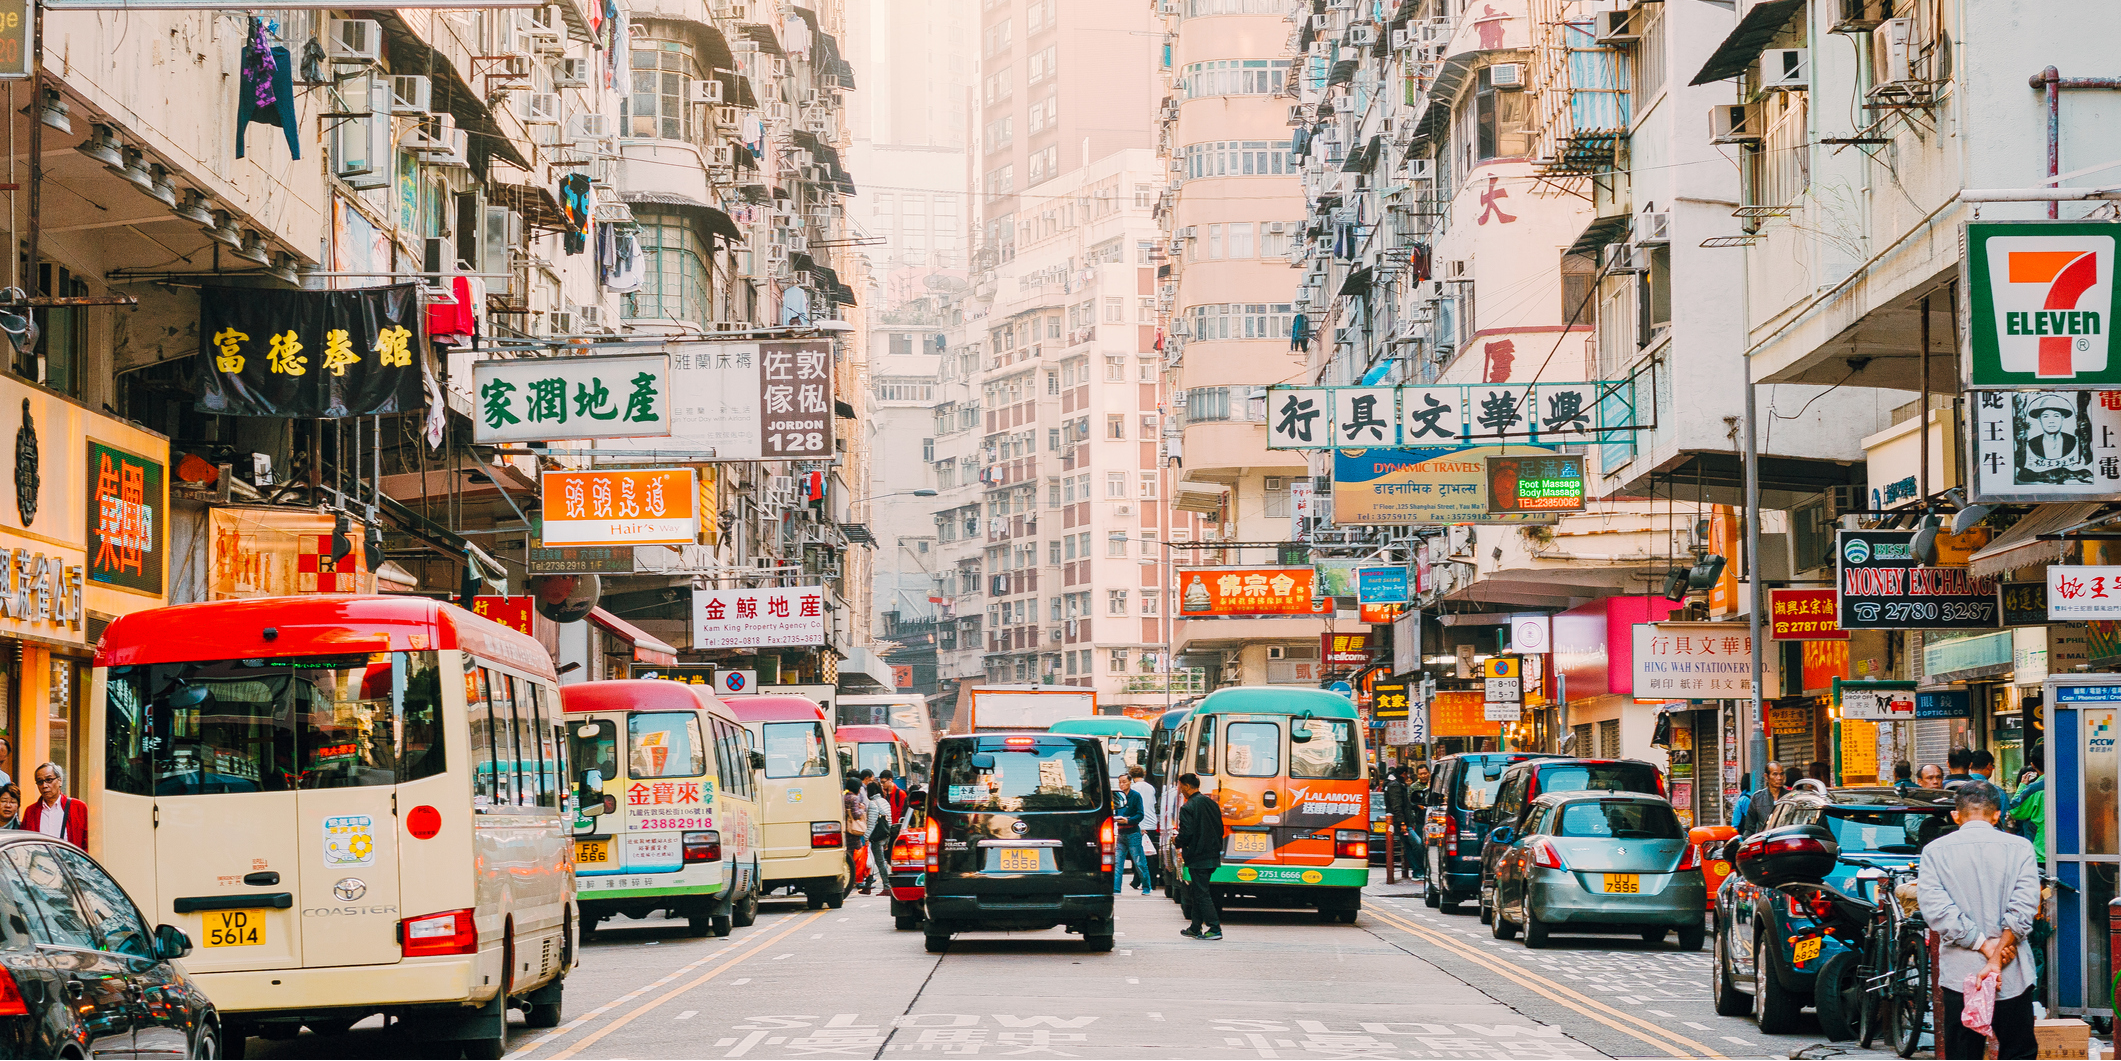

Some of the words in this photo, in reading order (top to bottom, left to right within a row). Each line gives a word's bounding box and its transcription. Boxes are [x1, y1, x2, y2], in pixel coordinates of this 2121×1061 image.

[213, 325, 413, 376] 富德拳館
[675, 353, 752, 370] 雅蘭床褥
[481, 372, 660, 430] 家潤地產
[768, 420, 824, 431] JORDON
[768, 432, 824, 451] 128
[1373, 463, 1430, 473] DYNAMIC
[1432, 463, 1480, 473] TRAVELS
[1519, 480, 1540, 489] Foot
[1542, 480, 1580, 489] Massage
[1519, 488, 1541, 498] Body
[1542, 488, 1580, 496] Massage
[1518, 498, 1579, 508] TEL:23850062
[611, 523, 655, 536] Hair's
[659, 525, 681, 533] Way
[566, 562, 587, 571] 2918
[1844, 567, 1906, 596] MONEY
[1908, 567, 1998, 596] EXCHANGE
[705, 593, 821, 620] 金鯨地產
[1885, 602, 1939, 621] 2780
[1942, 602, 1995, 621] 3287
[724, 624, 741, 633] King
[745, 623, 777, 632] Property
[779, 622, 807, 631] Agency
[811, 620, 823, 628] Co.
[1791, 621, 1818, 632] 2787
[1820, 620, 1839, 631] 079
[1644, 662, 1667, 672] HING
[1671, 662, 1691, 672] WAH
[1694, 662, 1750, 673] STATIONERY
[628, 782, 699, 805] 金寶來
[1304, 792, 1363, 803] LALAMOVE
[641, 818, 712, 829] 23882918
[1244, 833, 1258, 842] KT
[583, 844, 599, 852] FG
[1236, 842, 1265, 850] 3493
[576, 852, 606, 861] 1566
[1011, 850, 1028, 859] ML
[1002, 860, 1037, 869] 3858
[1259, 870, 1278, 878] 2751
[1280, 871, 1300, 879] 6666
[1614, 874, 1630, 883] UJ
[1606, 883, 1638, 893] 7995
[302, 905, 397, 917] COASTER
[221, 912, 247, 928] VD
[210, 928, 258, 945] 5614
[1801, 940, 1815, 951] PP
[732, 1013, 1100, 1029] SLOW
[1208, 1019, 1563, 1037] SLOW
